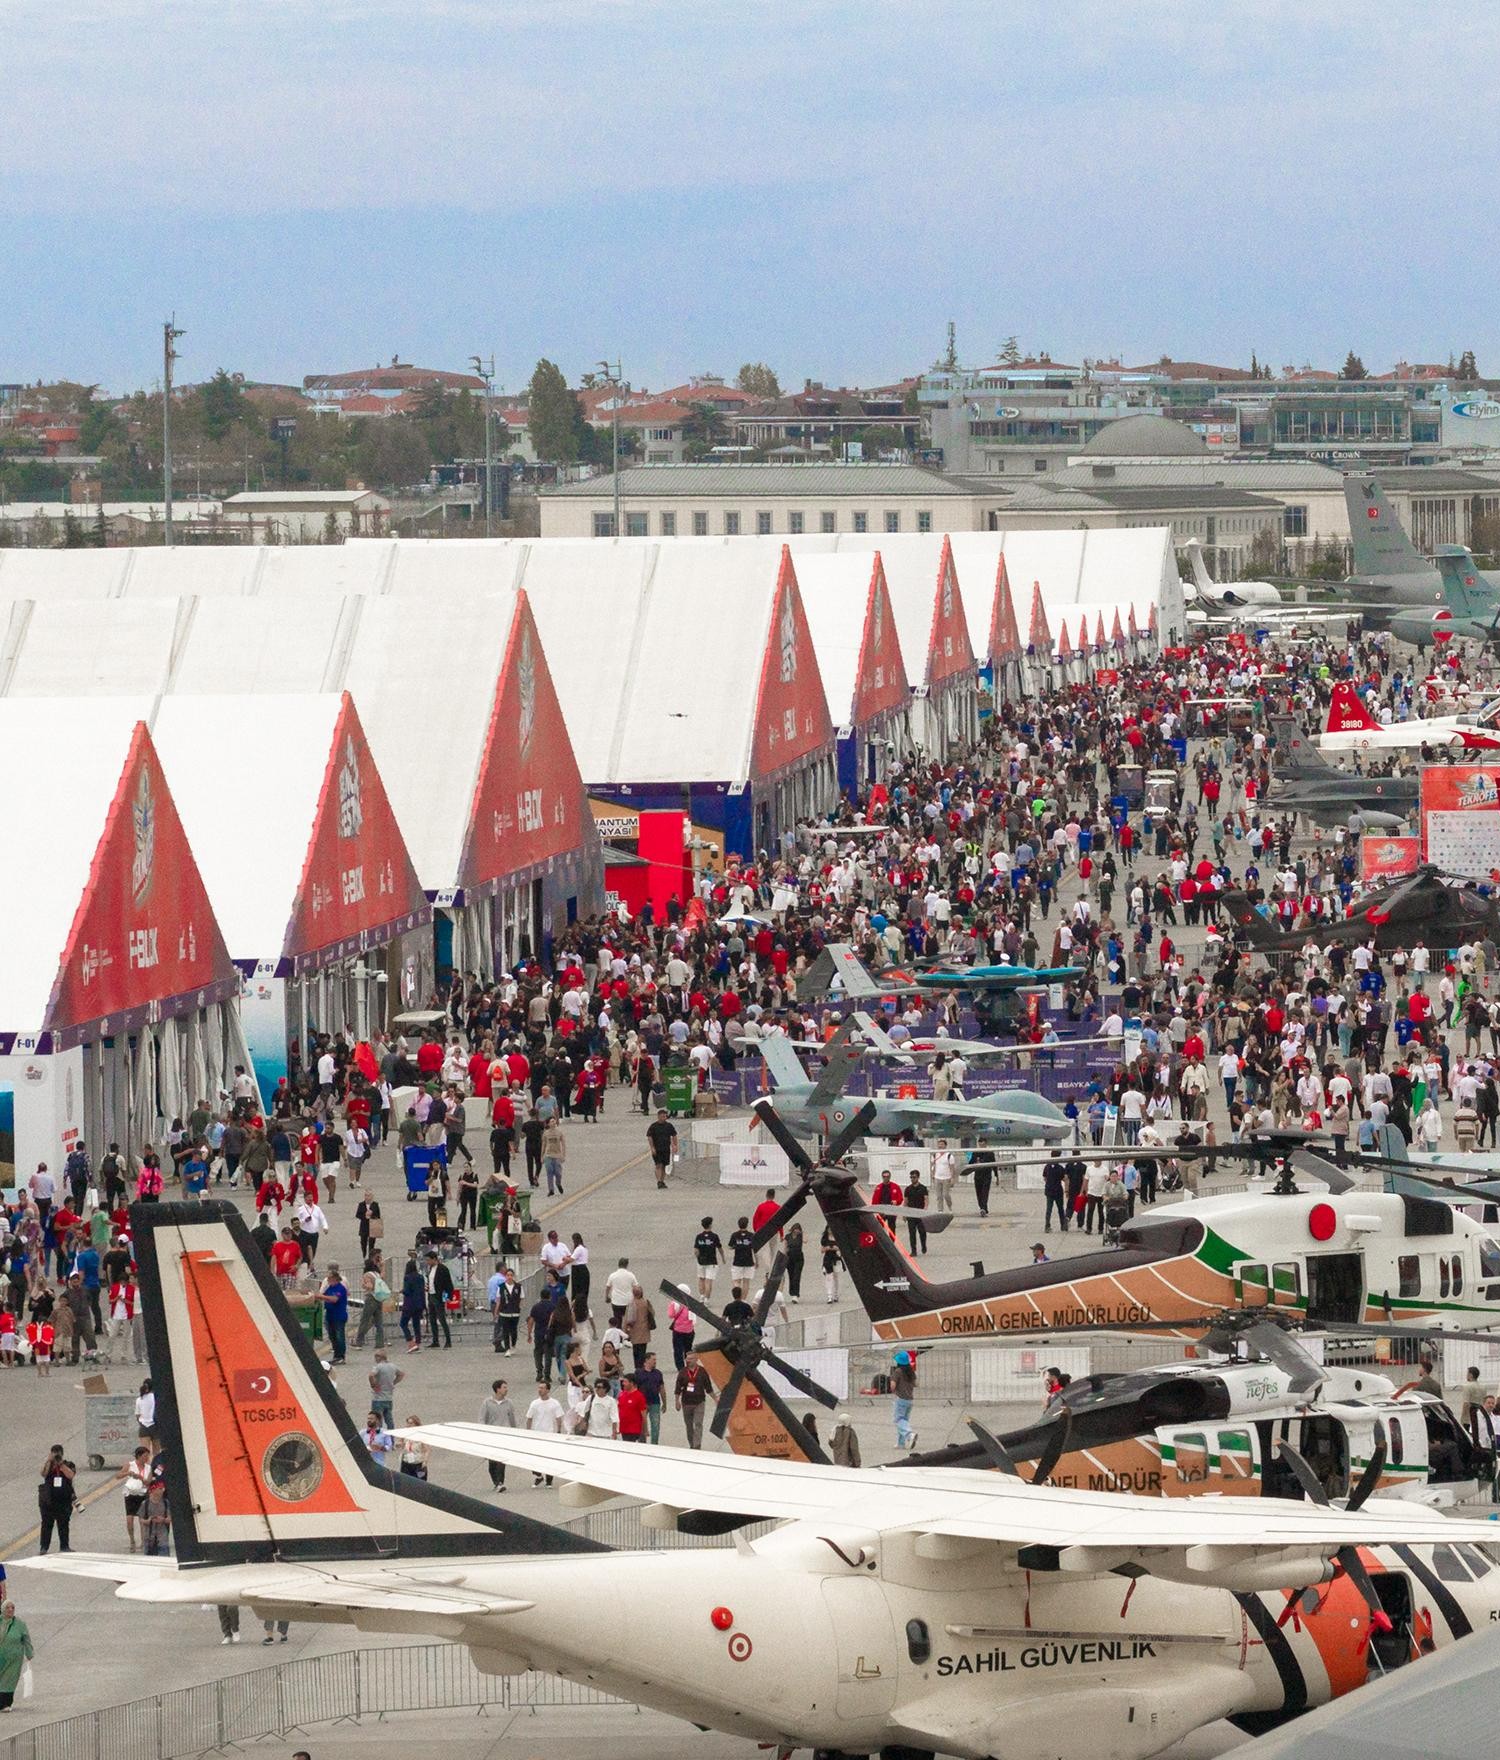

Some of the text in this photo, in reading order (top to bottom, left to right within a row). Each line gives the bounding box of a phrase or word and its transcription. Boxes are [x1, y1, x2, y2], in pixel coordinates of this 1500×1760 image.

[1468, 401, 1500, 416] Flyinn
[1457, 790, 1499, 807] TEKNOFES
[595, 818, 638, 826] ANTUM
[17, 1039, 35, 1049] F-01
[941, 1302, 1151, 1333] ORMAN GENEL MÜDÜRLÜĞÜ
[242, 1407, 297, 1422] TCSG-551
[936, 1647, 1016, 1677] SAHİL
